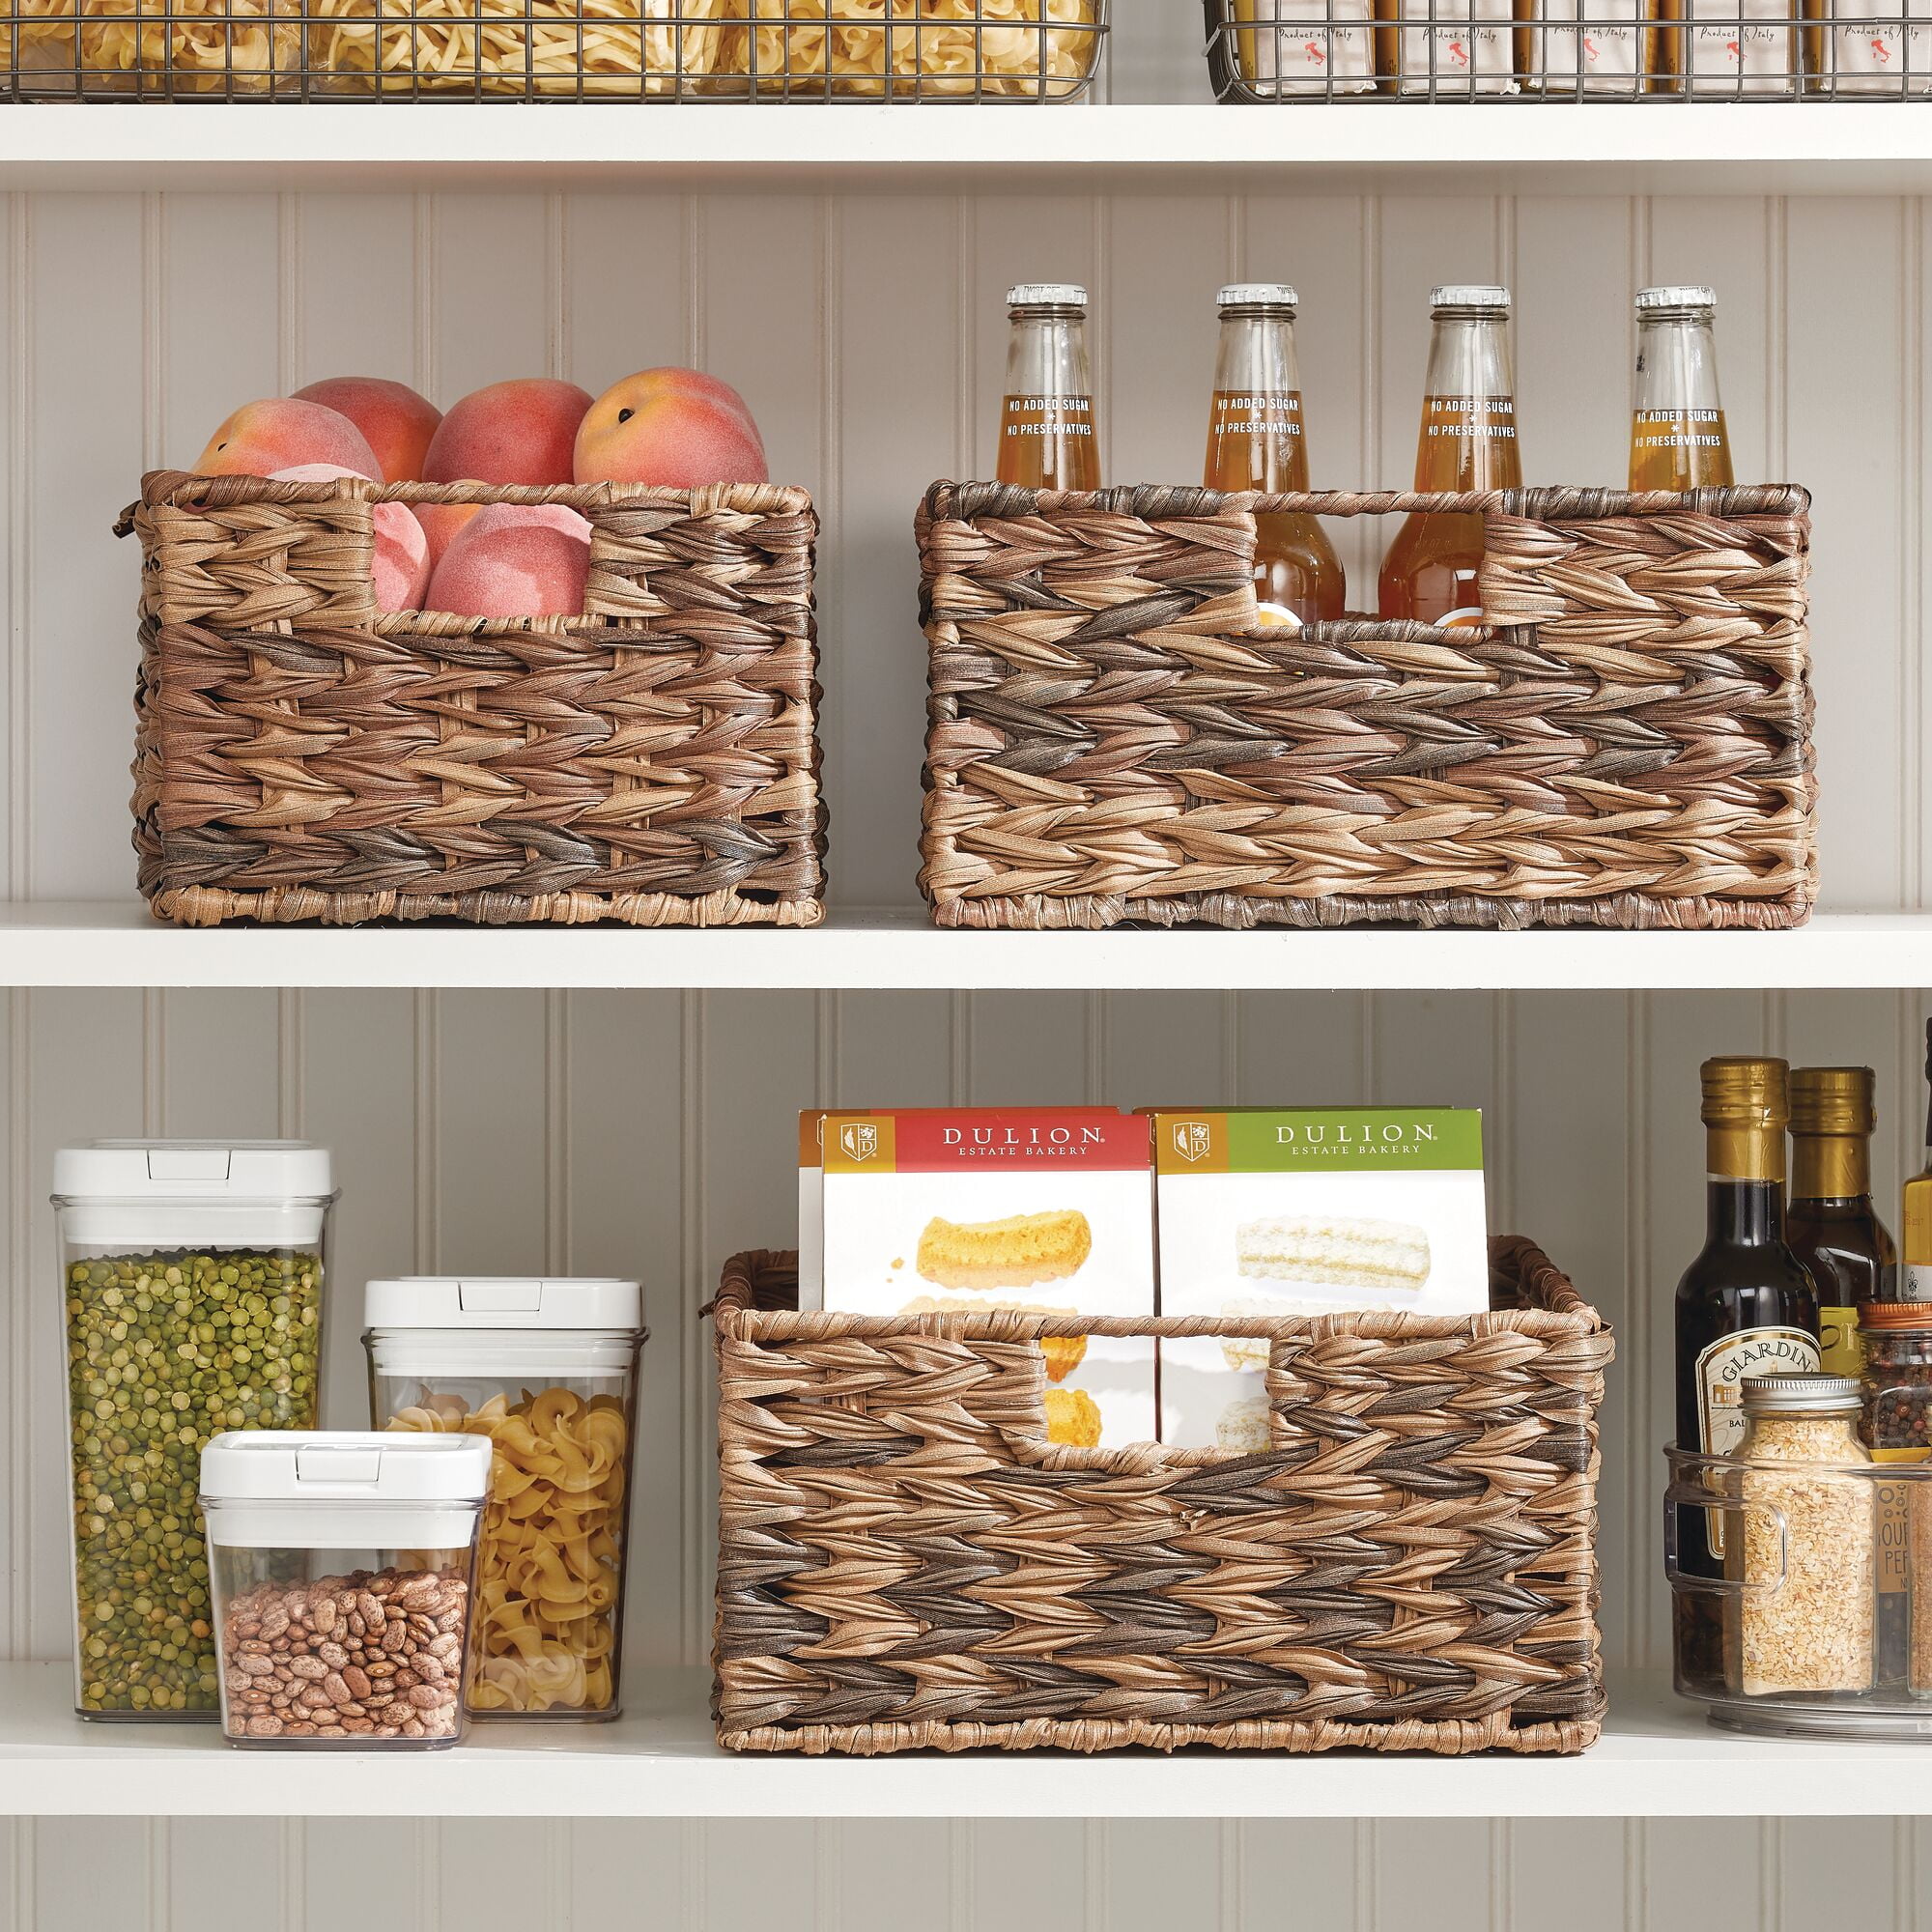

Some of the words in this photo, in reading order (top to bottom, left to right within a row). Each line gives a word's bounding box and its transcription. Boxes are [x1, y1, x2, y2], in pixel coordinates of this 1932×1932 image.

[1279, 28, 1313, 40] Product
[1318, 28, 1326, 42] of
[1593, 27, 1603, 40] of
[1700, 26, 1736, 39] Product
[1752, 26, 1775, 42] Italy
[1845, 25, 1880, 37] Product
[1884, 26, 1893, 40] of
[1896, 25, 1918, 40] Ily
[1009, 400, 1020, 412] NO
[1024, 399, 1059, 411] ADDED
[1063, 399, 1089, 412] SUGAR
[1217, 399, 1228, 410] NO
[1231, 398, 1265, 410] ADDED
[1270, 398, 1298, 411] SUGAR
[1431, 401, 1442, 412] NO
[1445, 400, 1481, 412] ADDED
[1485, 401, 1513, 413] SUGAR
[1636, 412, 1646, 423] NO
[1649, 411, 1683, 423] ADDED
[1688, 411, 1718, 422] SUGAR
[1008, 425, 1017, 436] NO
[1020, 423, 1092, 436] PRESERVATIVES
[1215, 424, 1225, 434] NO
[1228, 422, 1300, 435] PRESERVATIVES
[1428, 425, 1438, 436] NO
[1441, 425, 1515, 438] PRESERVATIVES
[1635, 438, 1643, 448] NO
[1646, 435, 1720, 447] PRESERVATIVES
[943, 1127, 1102, 1144] DULION
[1275, 1124, 1435, 1143] DULION
[959, 1147, 1016, 1155] ESTATE
[1025, 1147, 1088, 1155] BAKERY
[1293, 1146, 1350, 1155] ESTATE
[1359, 1145, 1420, 1154] BAKERY
[1722, 1341, 1813, 1382] GIARDIN
